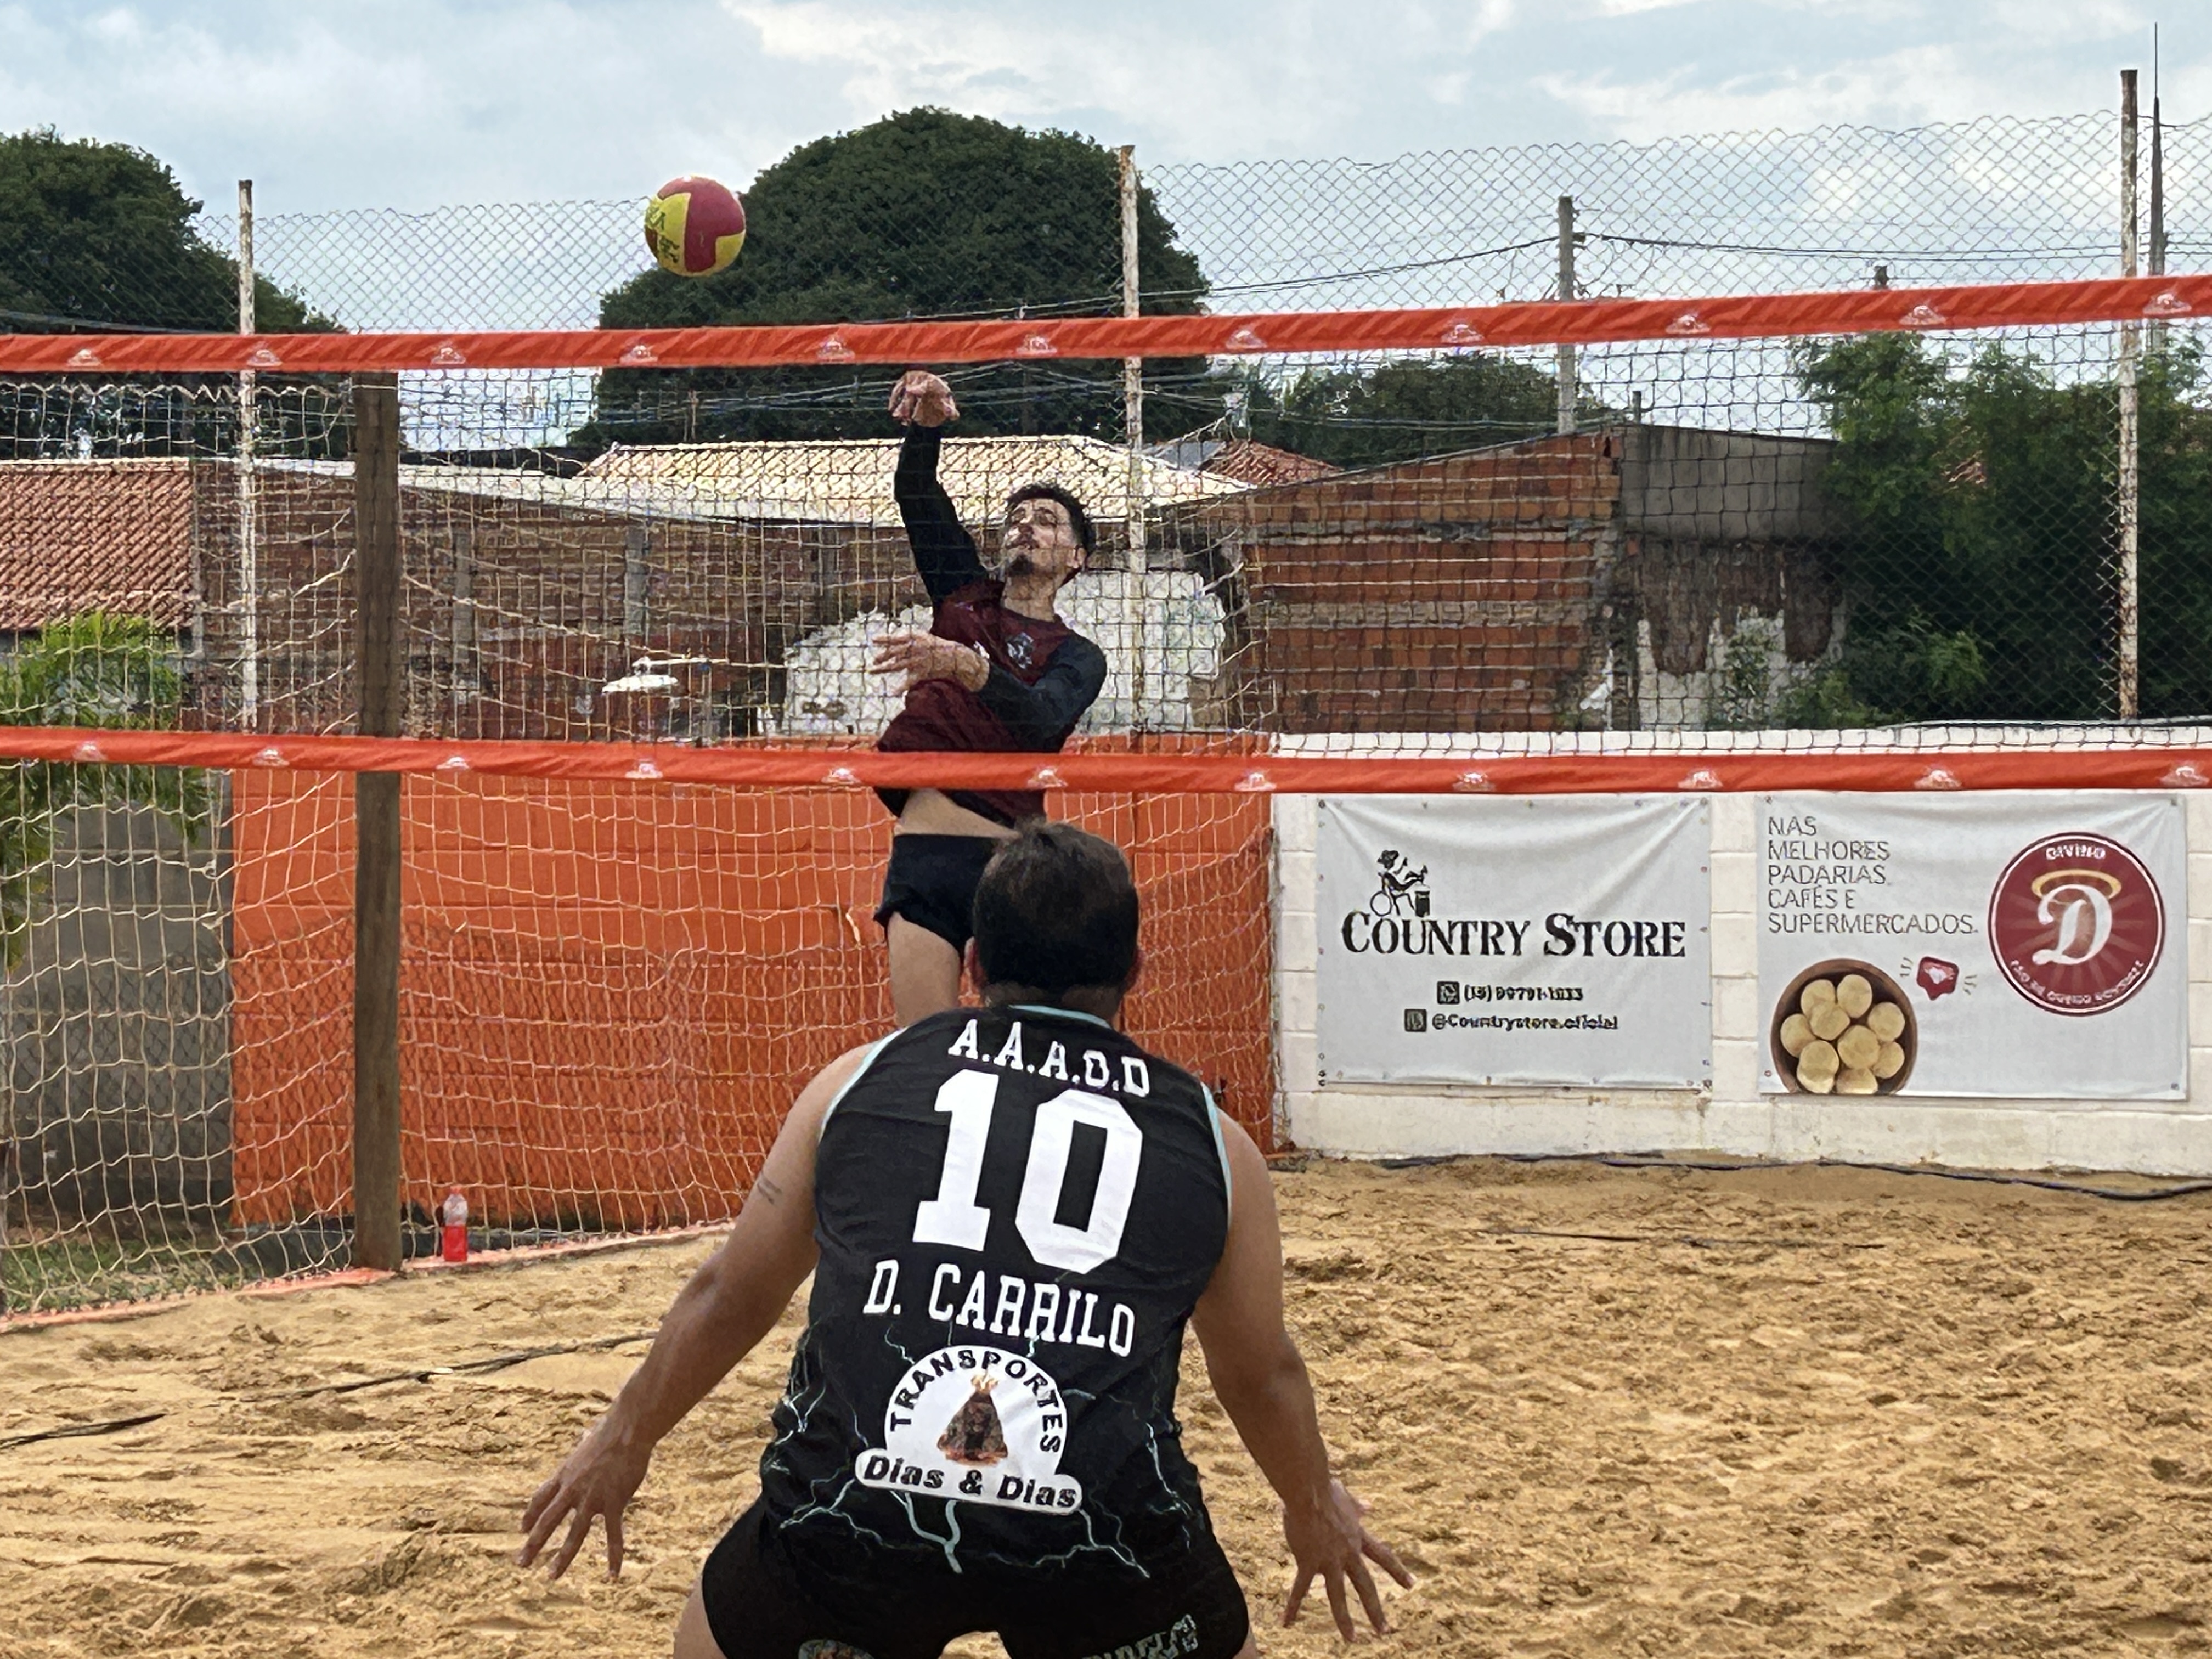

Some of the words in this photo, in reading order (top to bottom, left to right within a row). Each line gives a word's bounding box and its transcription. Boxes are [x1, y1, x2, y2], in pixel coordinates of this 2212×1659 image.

[1768, 815, 1817, 836] NAS
[1768, 840, 1891, 861] MELHORES
[1768, 885, 1837, 910] CAFÉS
[1845, 889, 1857, 910] E
[1342, 912, 1531, 956] COUNTRY
[1543, 913, 1685, 957] STORE
[1768, 912, 1979, 934] SUPERMERCADOS.
[913, 1069, 1143, 1274] 10
[863, 1260, 901, 1315] D.
[928, 1263, 1135, 1357] CARRILO
[889, 1349, 1063, 1454] TRANSPORTES
[864, 1455, 945, 1489] Dias
[958, 1470, 984, 1496] &
[996, 1474, 1078, 1508] Dias
